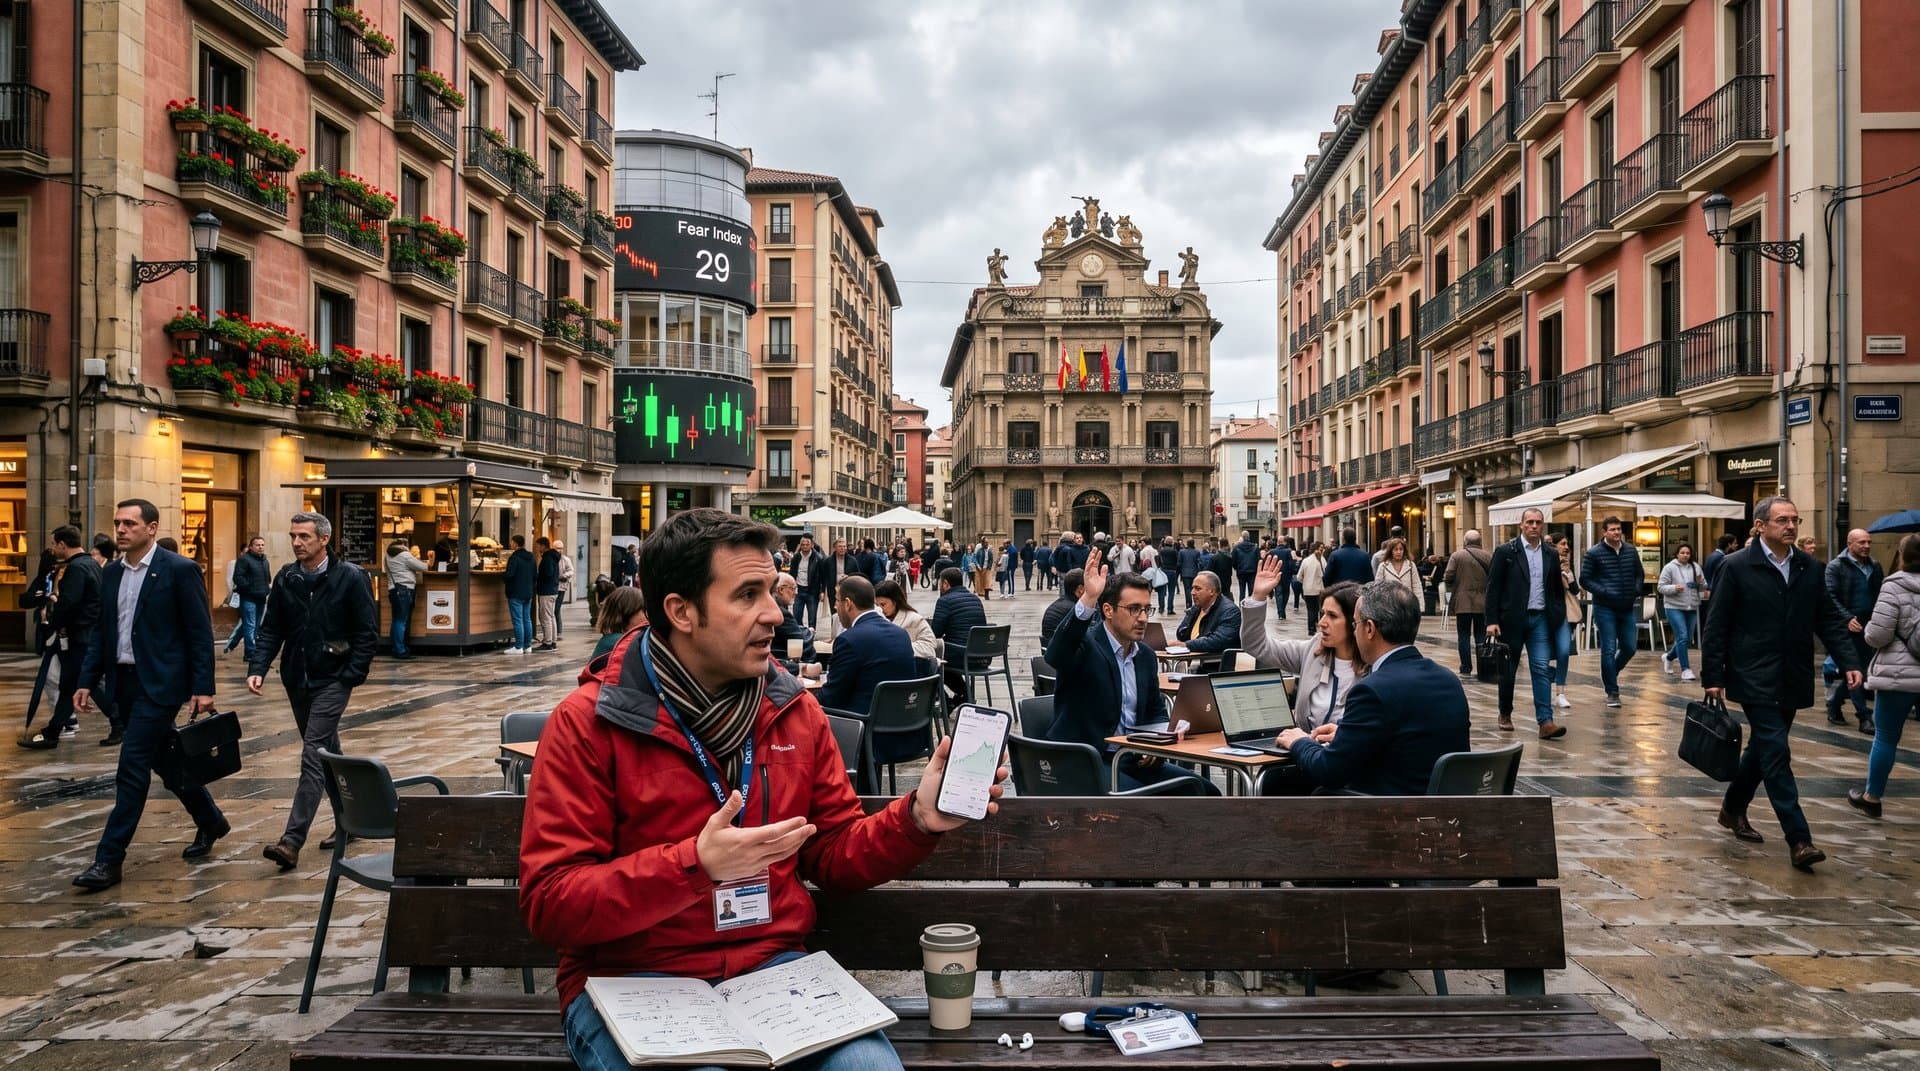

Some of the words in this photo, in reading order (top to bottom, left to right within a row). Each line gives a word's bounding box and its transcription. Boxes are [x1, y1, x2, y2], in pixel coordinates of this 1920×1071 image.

[678, 220, 710, 238] Fear
[713, 226, 743, 246] Index
[695, 249, 730, 283] 29
